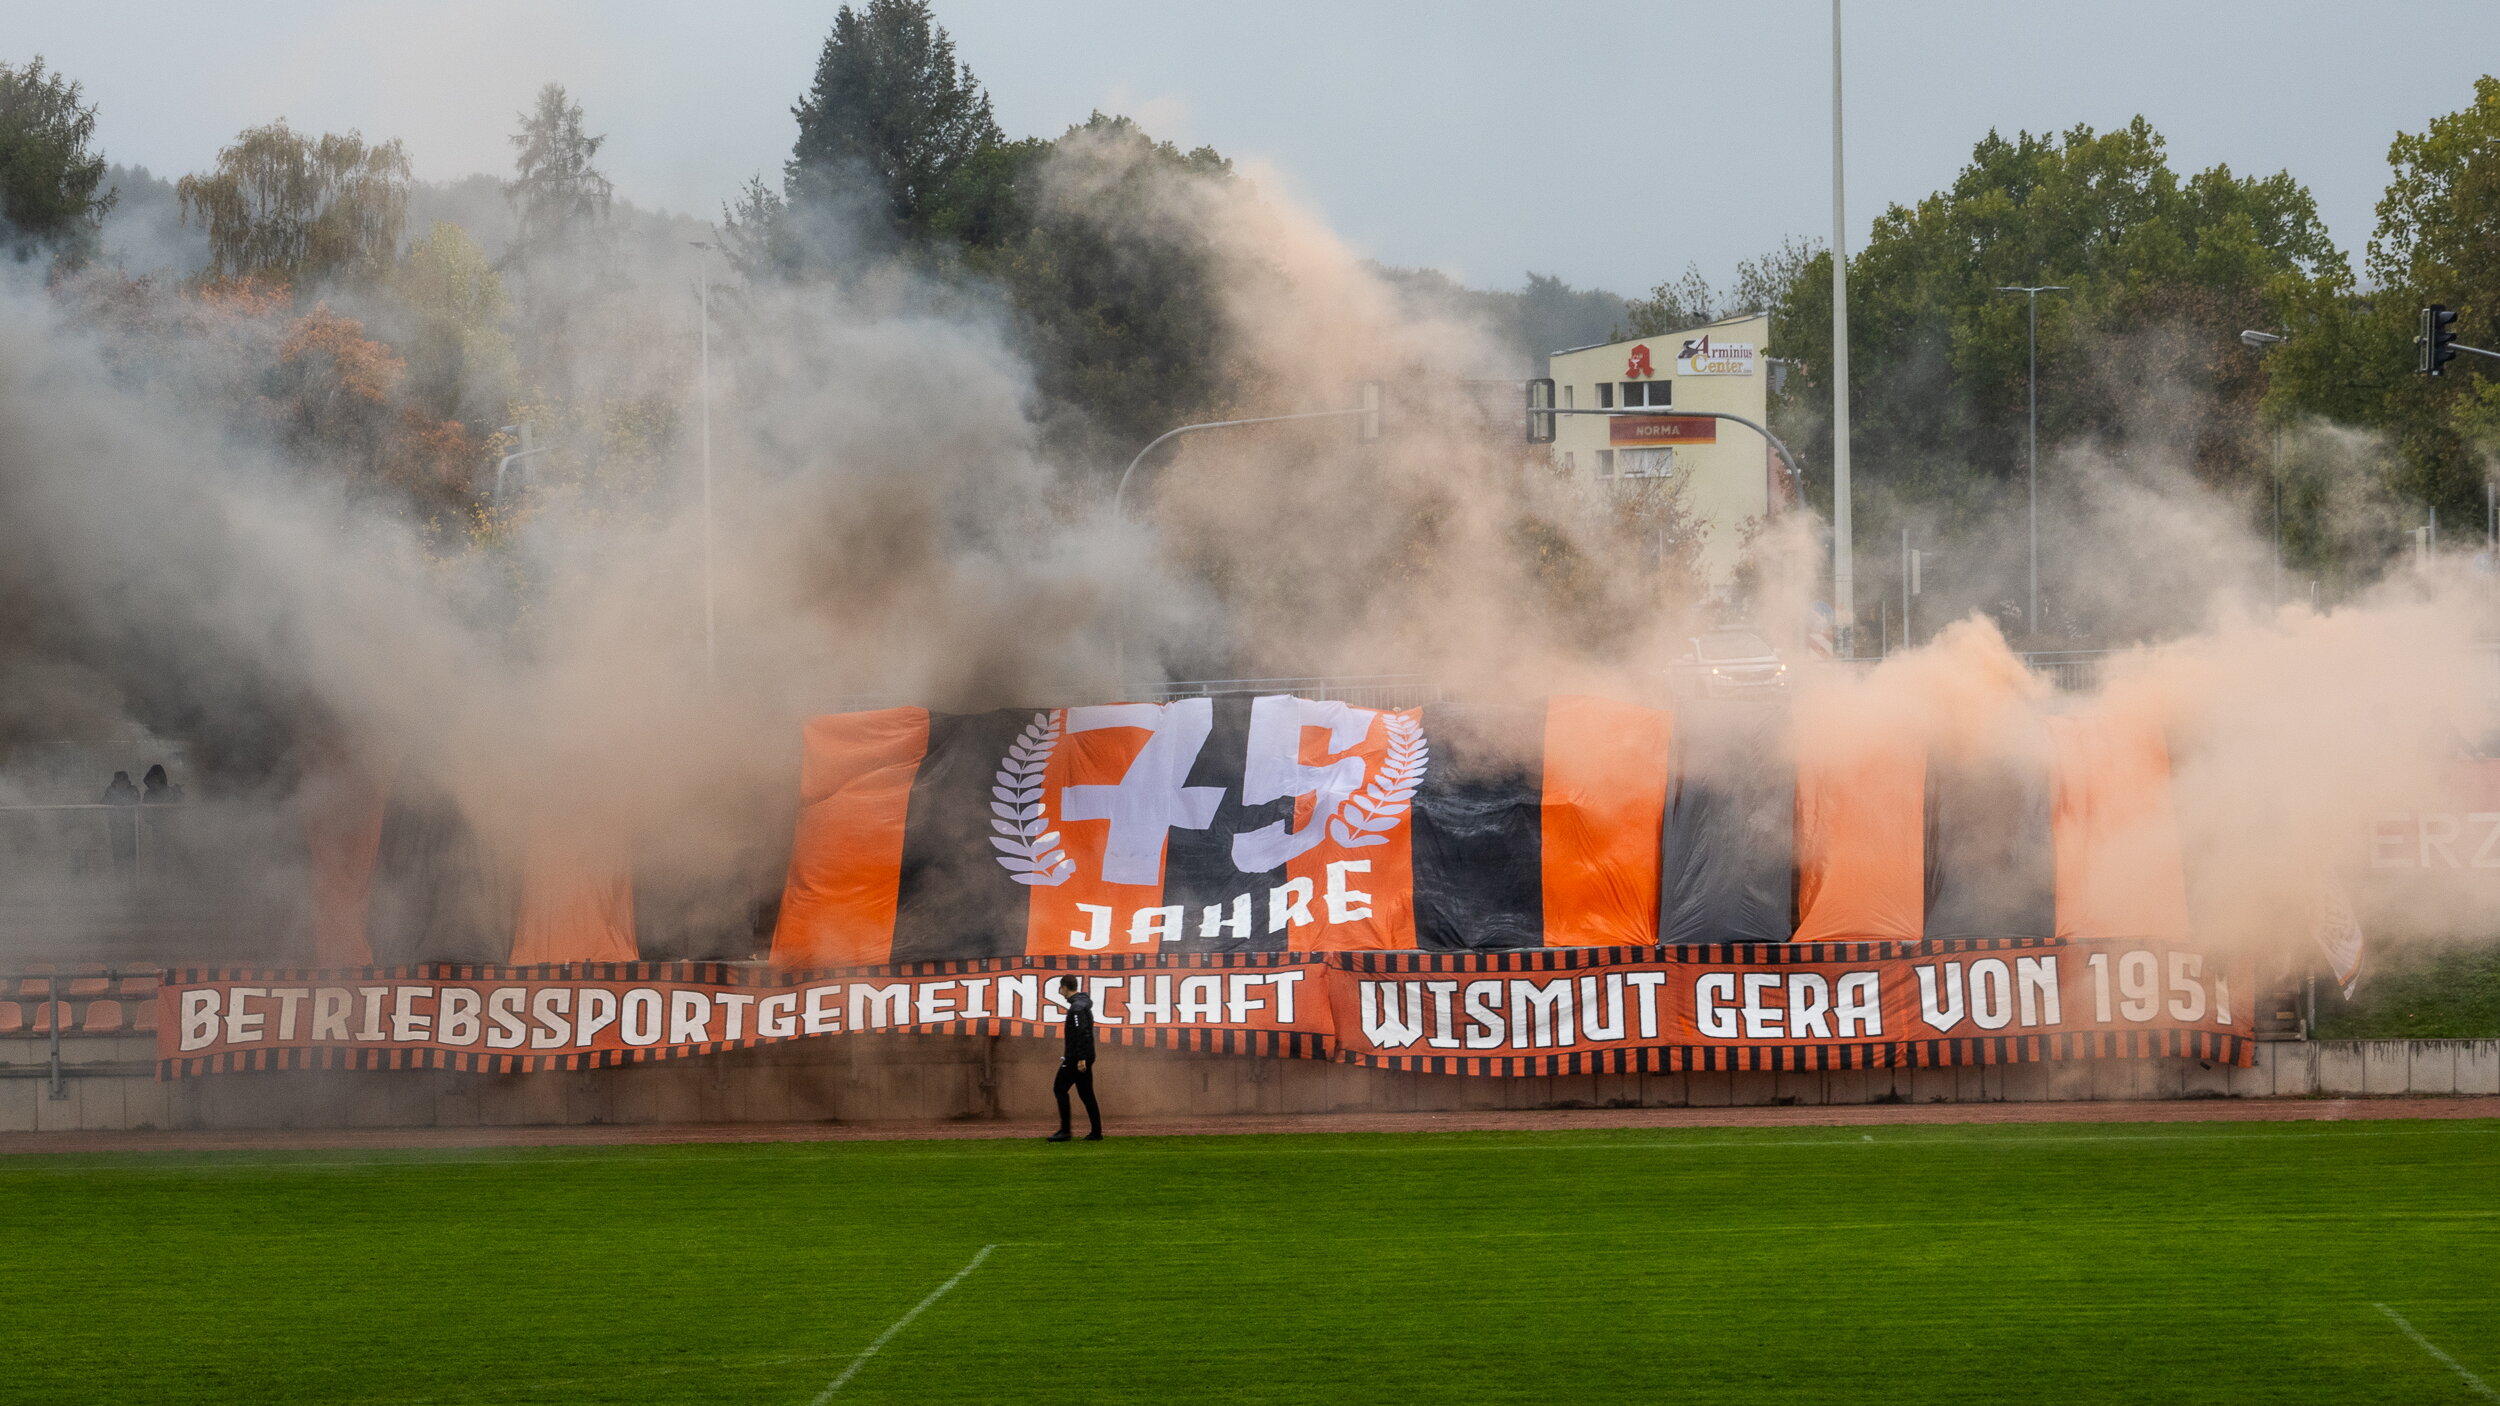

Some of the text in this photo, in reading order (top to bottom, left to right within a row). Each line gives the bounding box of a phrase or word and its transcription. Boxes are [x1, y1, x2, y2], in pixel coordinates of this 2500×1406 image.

[1691, 353, 1743, 373] Center
[1692, 334, 1752, 358] Arminius
[1636, 425, 1680, 436] NORMA
[1061, 694, 1378, 886] 75
[1069, 859, 1372, 949] JAHRE
[1359, 971, 1666, 1050] WISMUT
[1695, 971, 1882, 1038] GERA
[1914, 955, 2062, 1034] VON
